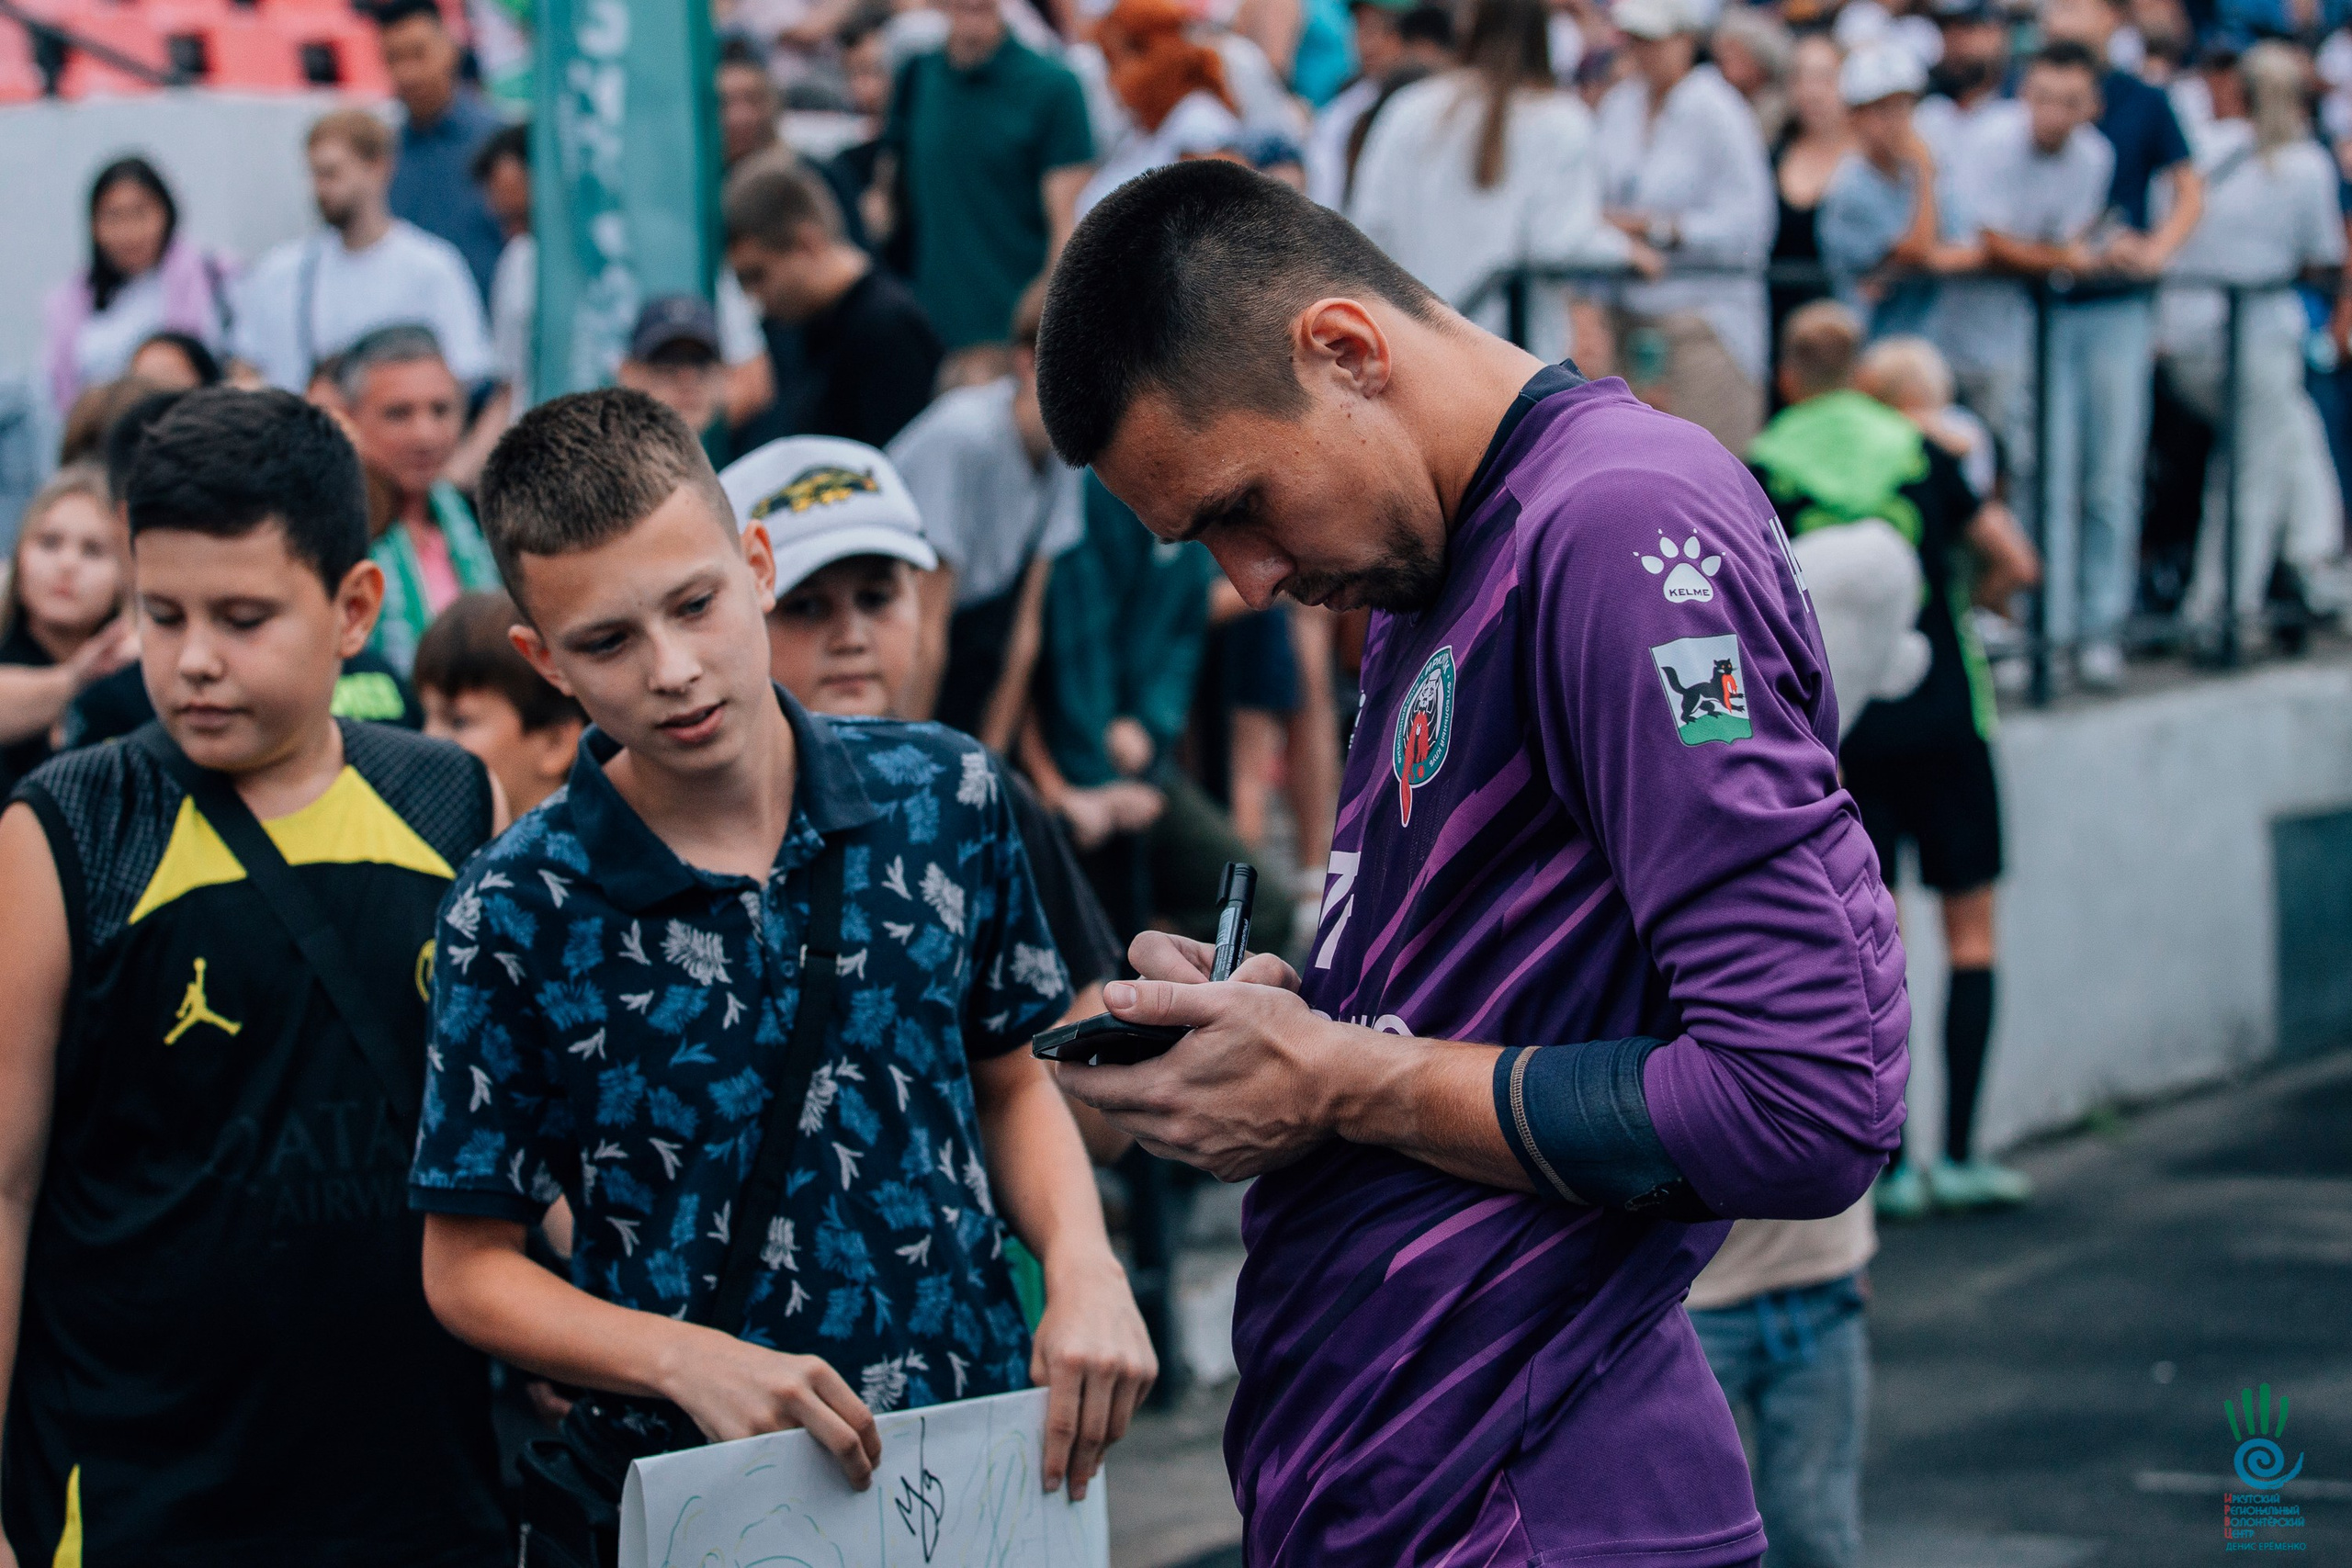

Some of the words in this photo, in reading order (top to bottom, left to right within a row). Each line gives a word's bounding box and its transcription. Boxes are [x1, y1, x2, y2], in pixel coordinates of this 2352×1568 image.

[1669, 588, 1710, 597] KELME
[1441, 681, 1452, 747] ФУТБОЛЬНЫЙ
[1429, 746, 1443, 768] КЛУБ
